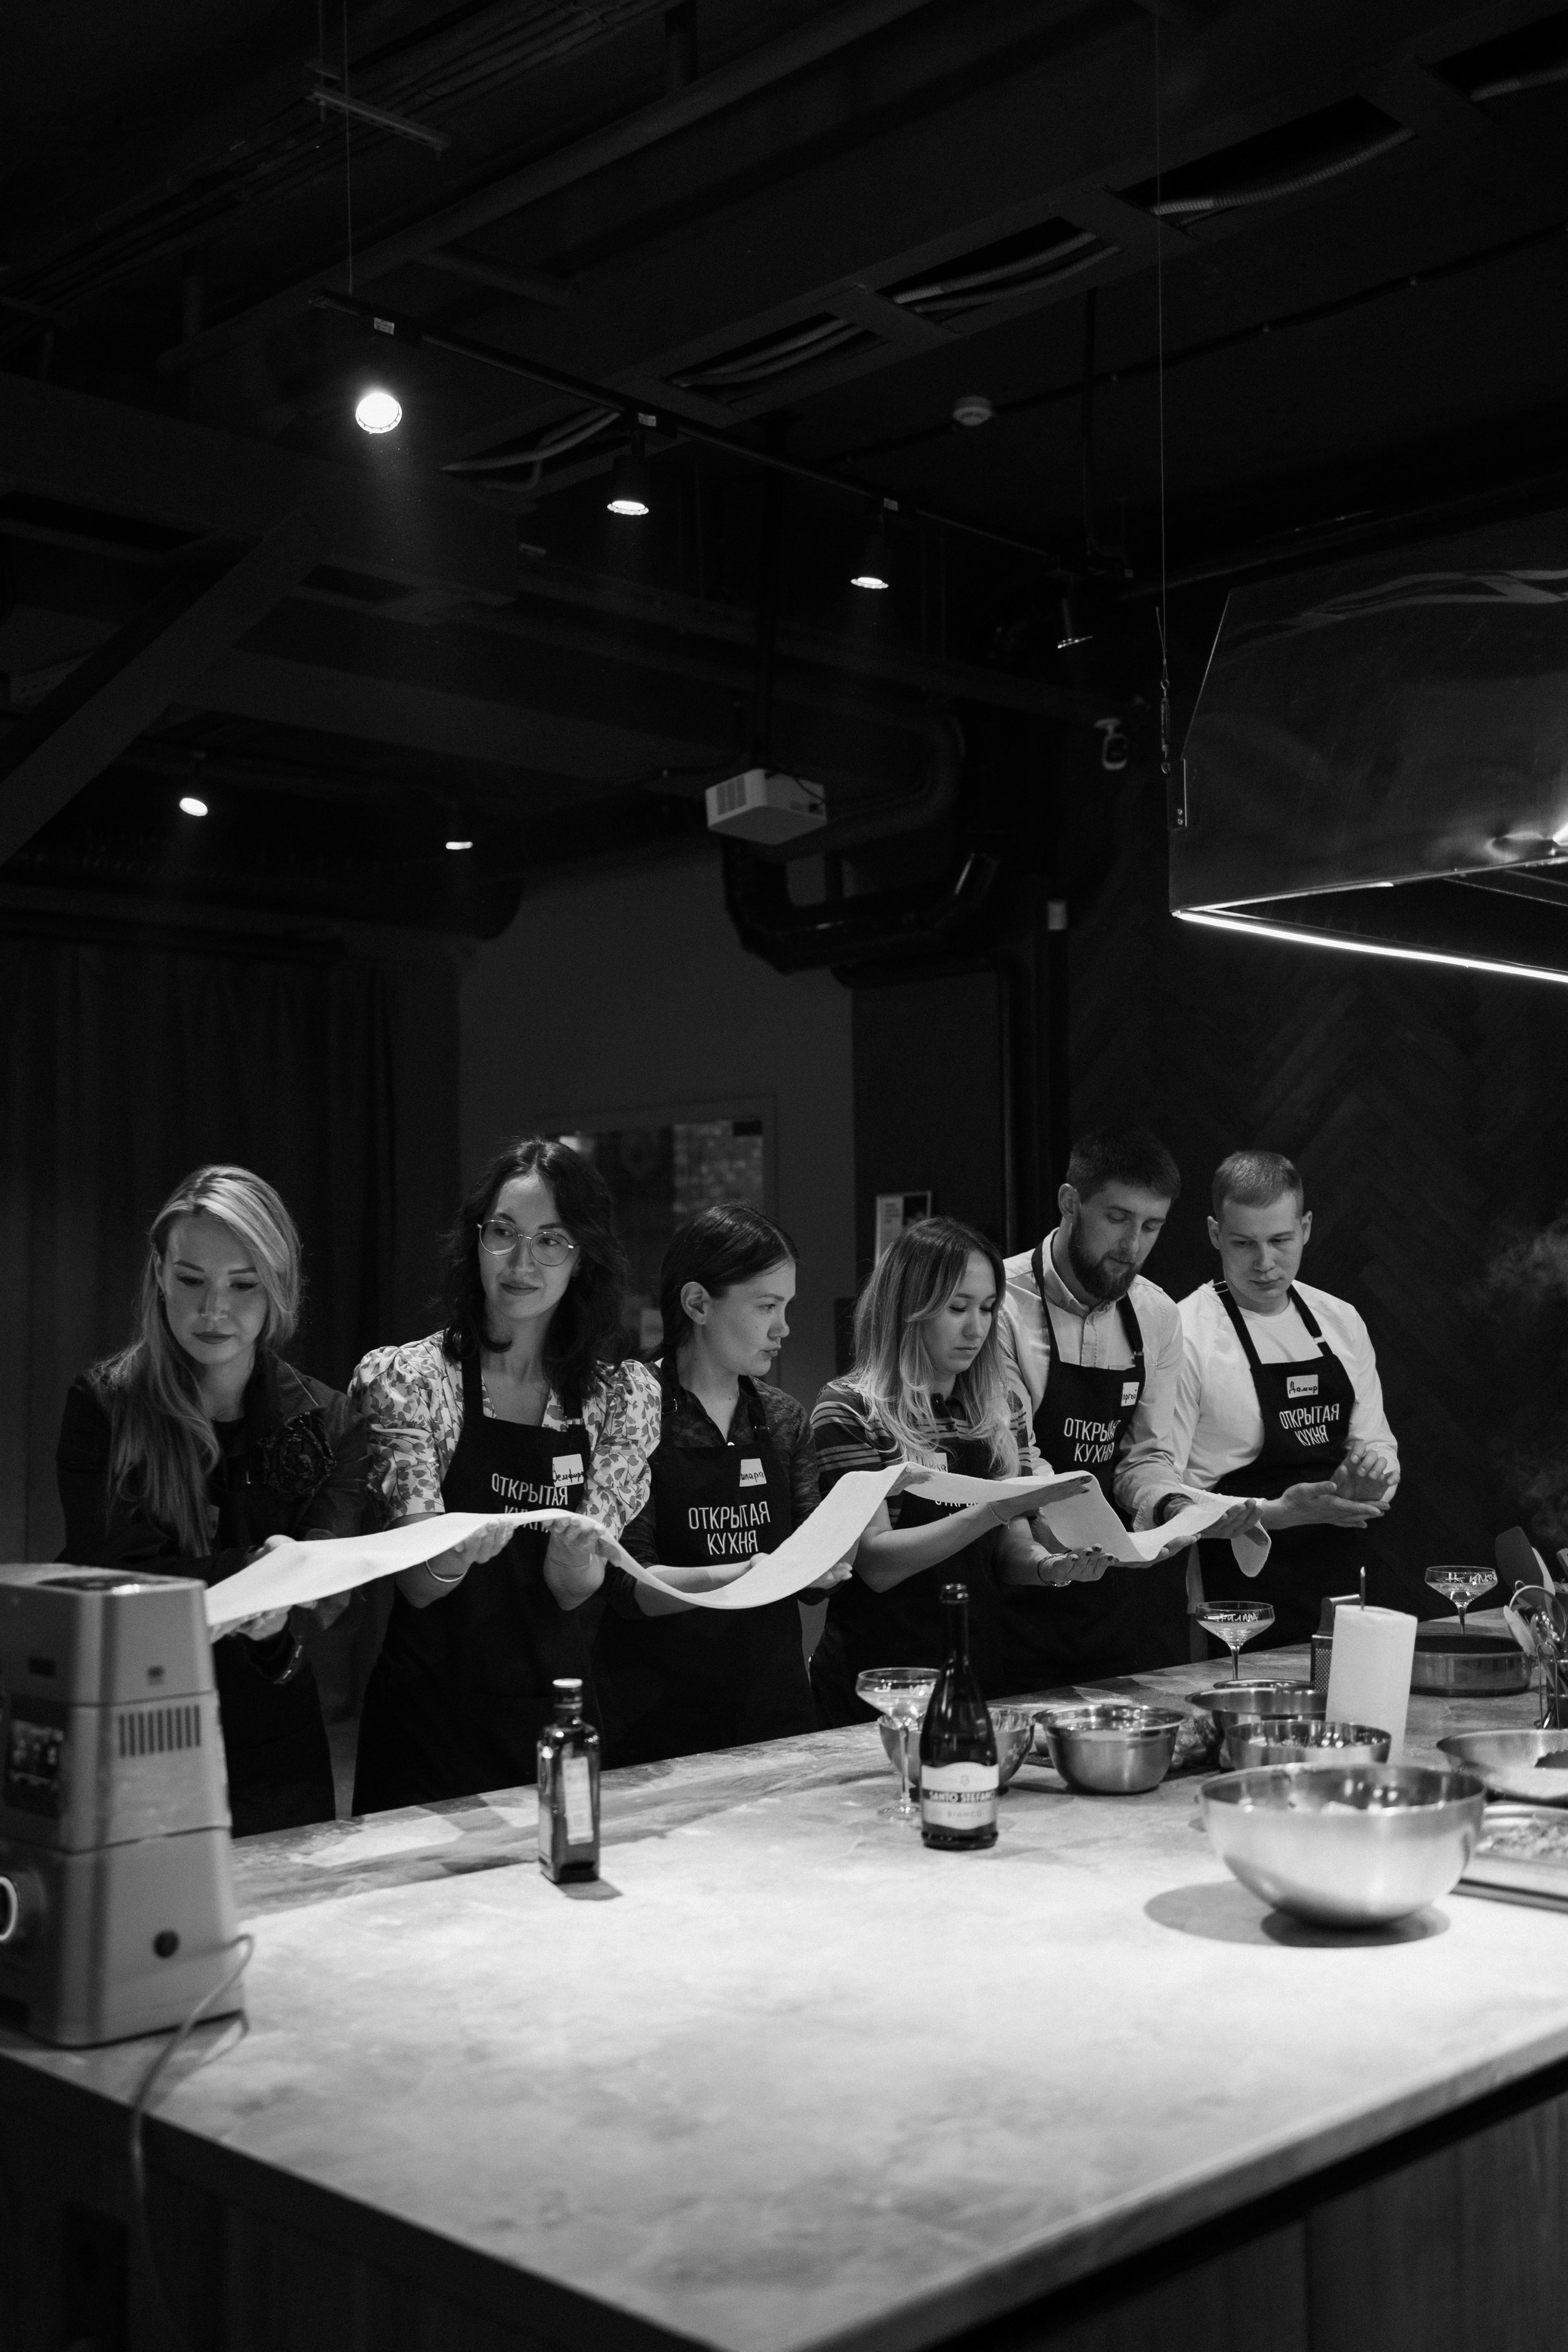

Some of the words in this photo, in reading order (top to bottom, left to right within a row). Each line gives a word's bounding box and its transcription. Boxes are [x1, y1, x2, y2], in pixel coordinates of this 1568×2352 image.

[1122, 1389, 1137, 1404] ергей
[1289, 1381, 1317, 1394] Дамир
[1279, 1403, 1340, 1429] ОТКРЫТАЯ
[1294, 1425, 1329, 1446] КУХНЯ
[1074, 1442, 1115, 1463] КУХНЯ
[740, 1471, 764, 1483] илара
[492, 1473, 568, 1506] ОТКРЫТАЯ
[688, 1501, 771, 1529] ОТКРЫТАЯ
[707, 1530, 759, 1555] КУХНЯ
[929, 1790, 959, 1803] SANTO
